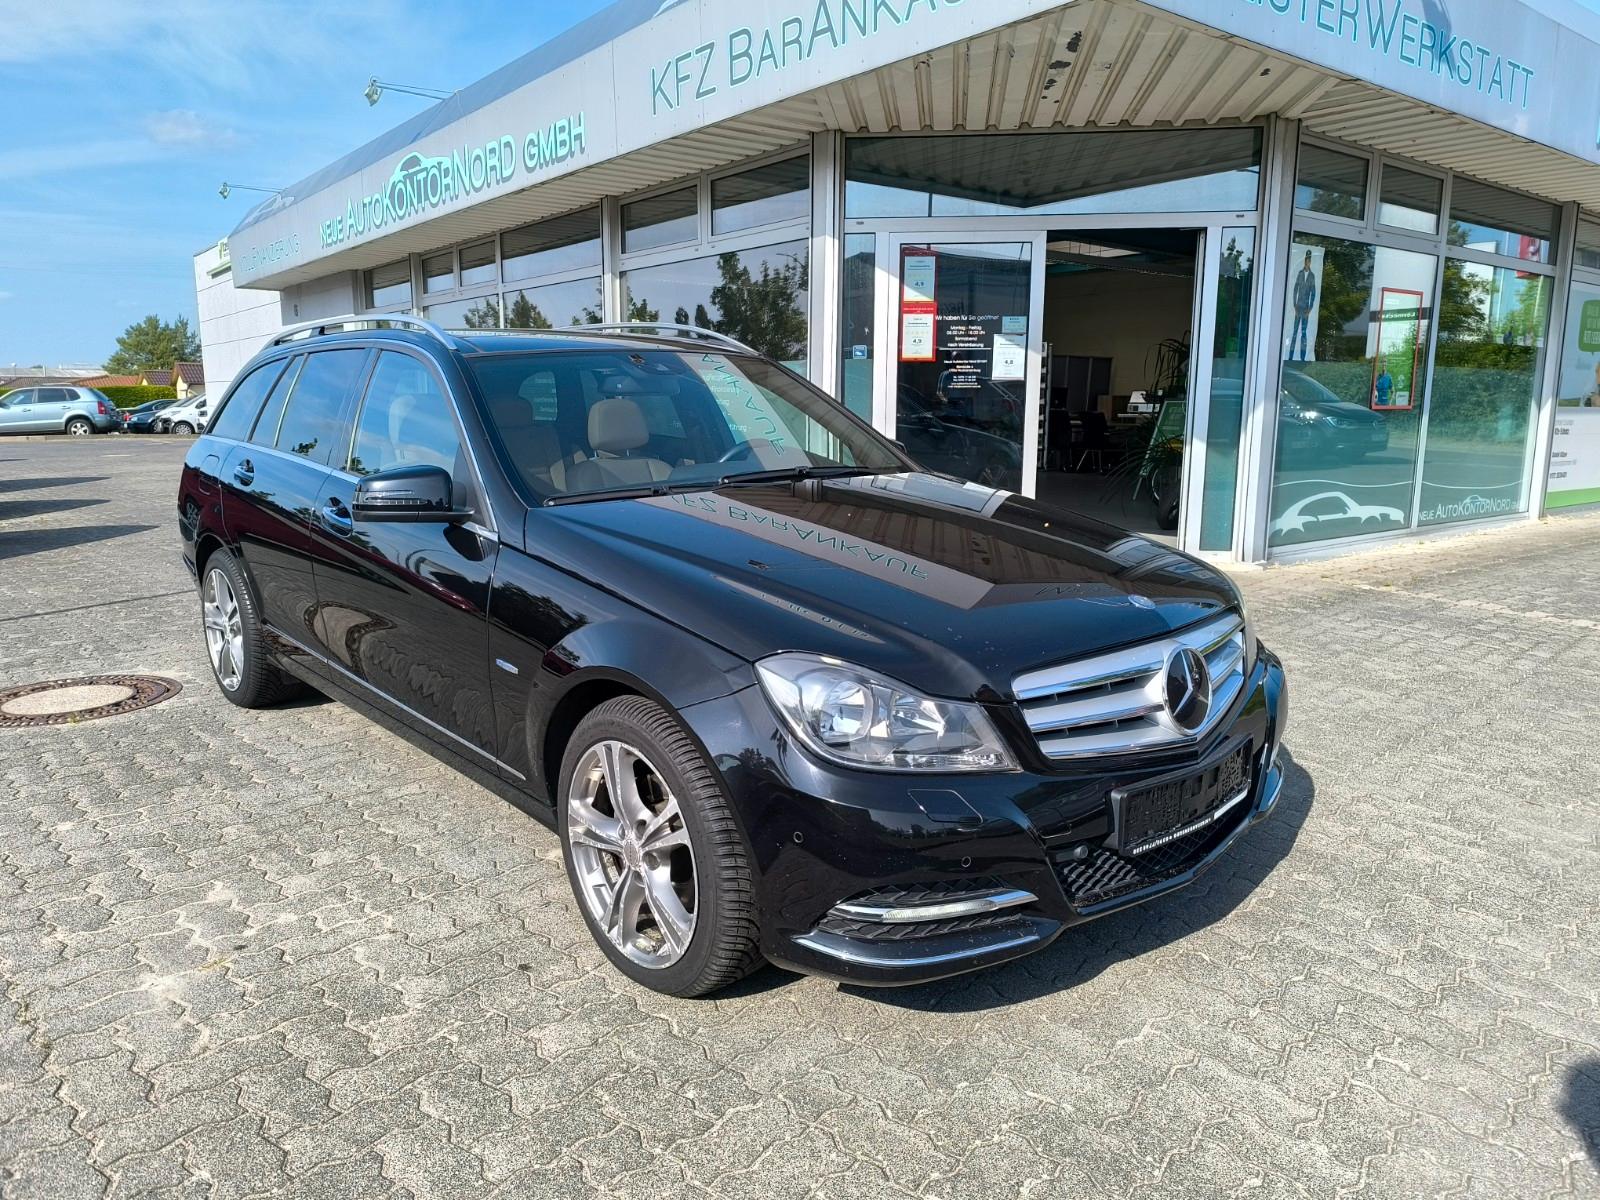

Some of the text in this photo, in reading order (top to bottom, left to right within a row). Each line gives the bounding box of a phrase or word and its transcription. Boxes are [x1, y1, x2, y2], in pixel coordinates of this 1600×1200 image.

[651, 0, 961, 116] KFZ BARANK
[319, 215, 344, 246] NEUE
[523, 111, 587, 170] GMBH
